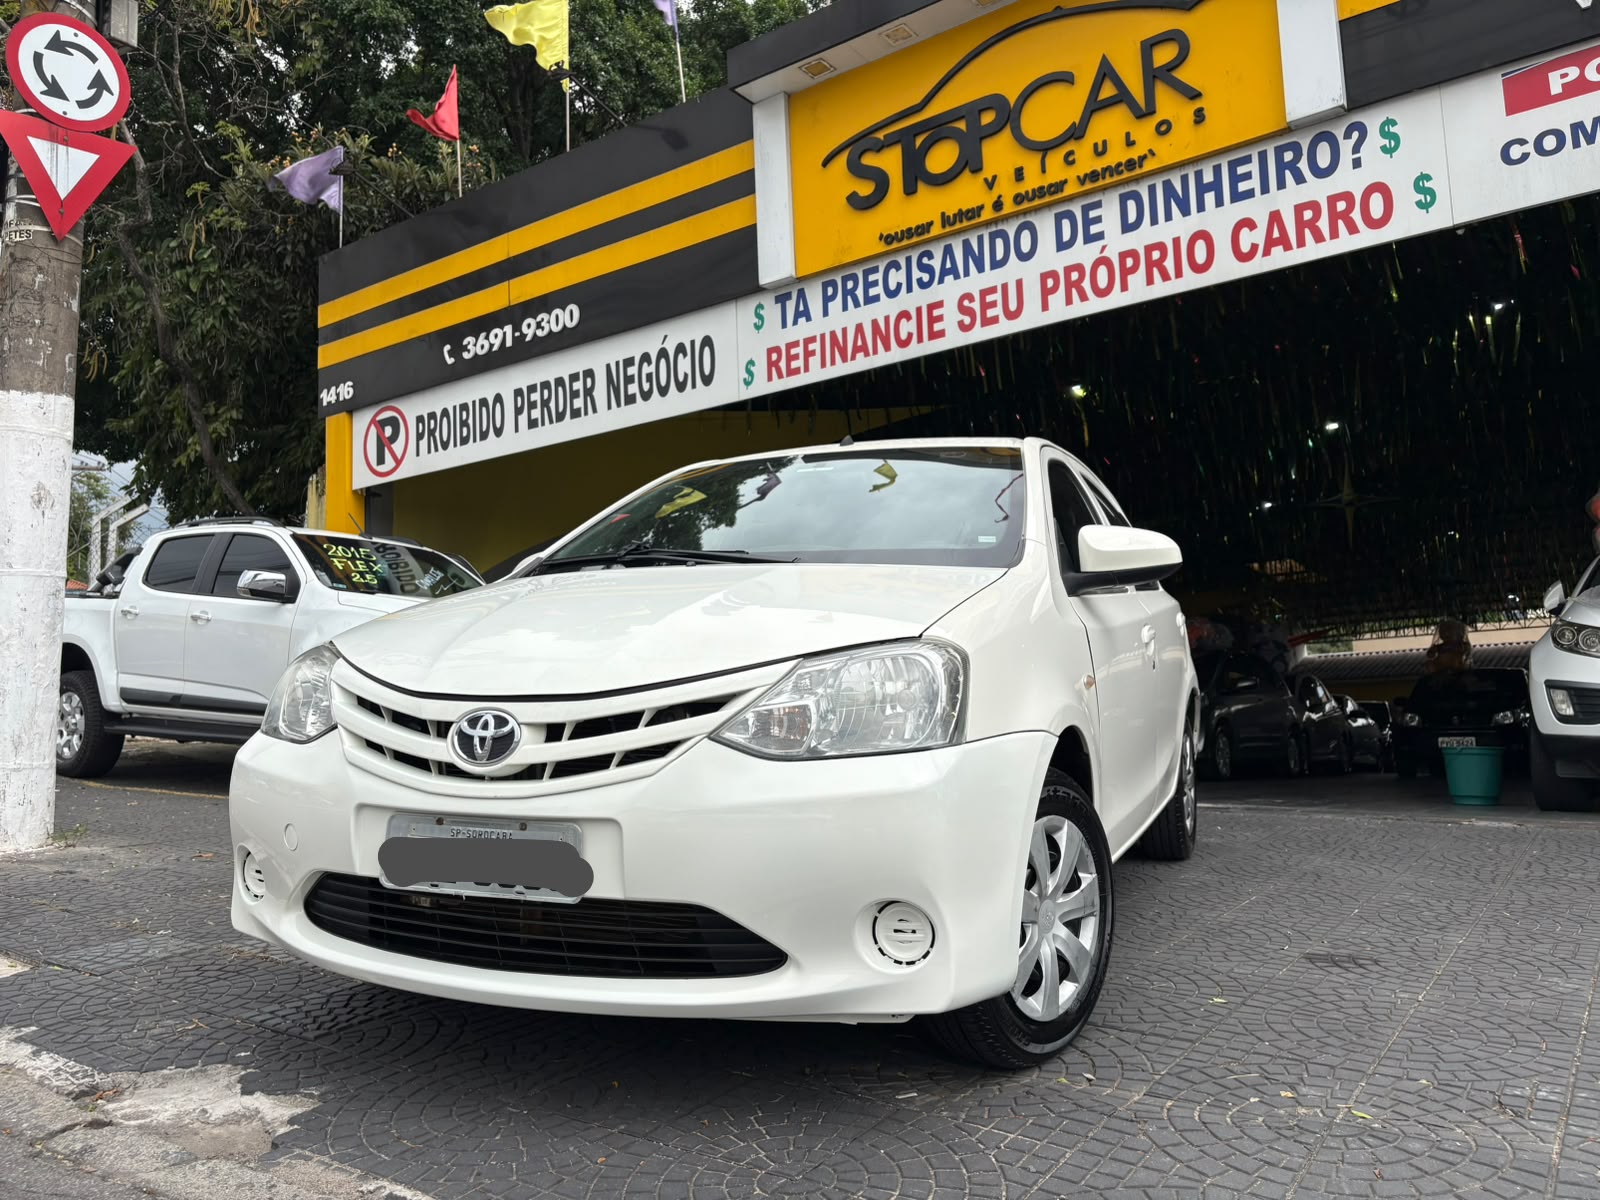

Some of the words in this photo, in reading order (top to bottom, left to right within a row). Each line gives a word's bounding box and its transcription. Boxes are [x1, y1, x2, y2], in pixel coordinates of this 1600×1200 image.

[846, 28, 1202, 210] STOPCAR
[984, 106, 1207, 190] VEÍCULOS
[753, 302, 766, 333] $
[774, 288, 813, 330] TA
[822, 221, 1039, 319] PRECISANDO
[1054, 199, 1106, 253] DE
[1119, 120, 1369, 235] DINHEIRO?
[1379, 117, 1401, 158] $
[940, 200, 984, 229] lutar
[992, 194, 1004, 213] é
[1012, 178, 1068, 206] ousar
[743, 359, 757, 389] $
[766, 300, 946, 383] REFINANCIE
[957, 278, 1024, 333] SEU
[1040, 229, 1216, 313] PRÓPRIO
[1230, 181, 1394, 263] CARRO
[1413, 172, 1438, 213] $
[461, 303, 581, 360] 3691-9300
[320, 380, 354, 407] 1416
[416, 393, 505, 457] PROIBIDO
[514, 368, 597, 433] PERDER
[606, 335, 716, 410] NEGÓCIO
[323, 543, 376, 561] 2015
[330, 558, 383, 573] FLEX
